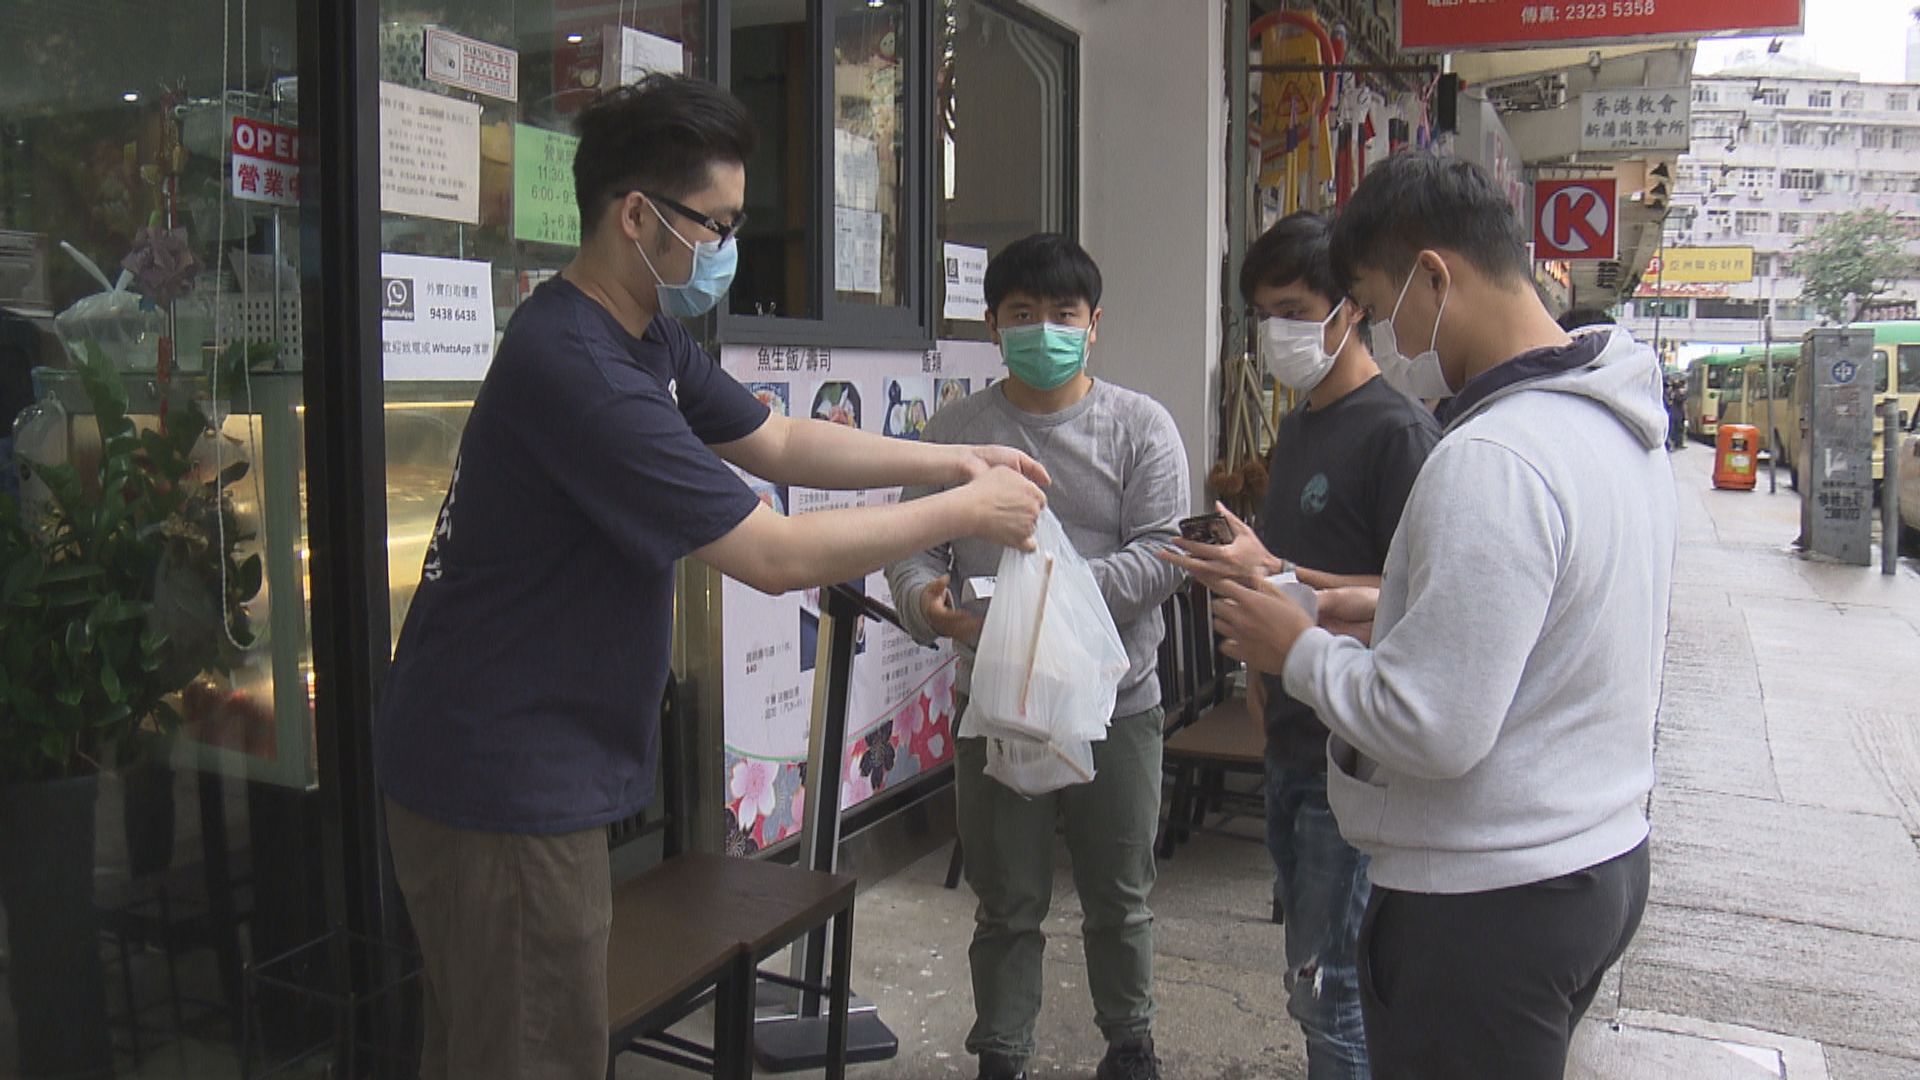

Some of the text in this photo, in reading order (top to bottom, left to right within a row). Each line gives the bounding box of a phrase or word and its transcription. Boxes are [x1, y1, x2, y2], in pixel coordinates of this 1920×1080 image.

[1565, 3, 1607, 20] 2323
[1592, 93, 1679, 118] 香港教會
[531, 184, 553, 201] 6:00
[430, 307, 477, 321] 9438 6438
[432, 343, 471, 356] WhatsApp
[757, 347, 832, 373] 魚生飯/壽司
